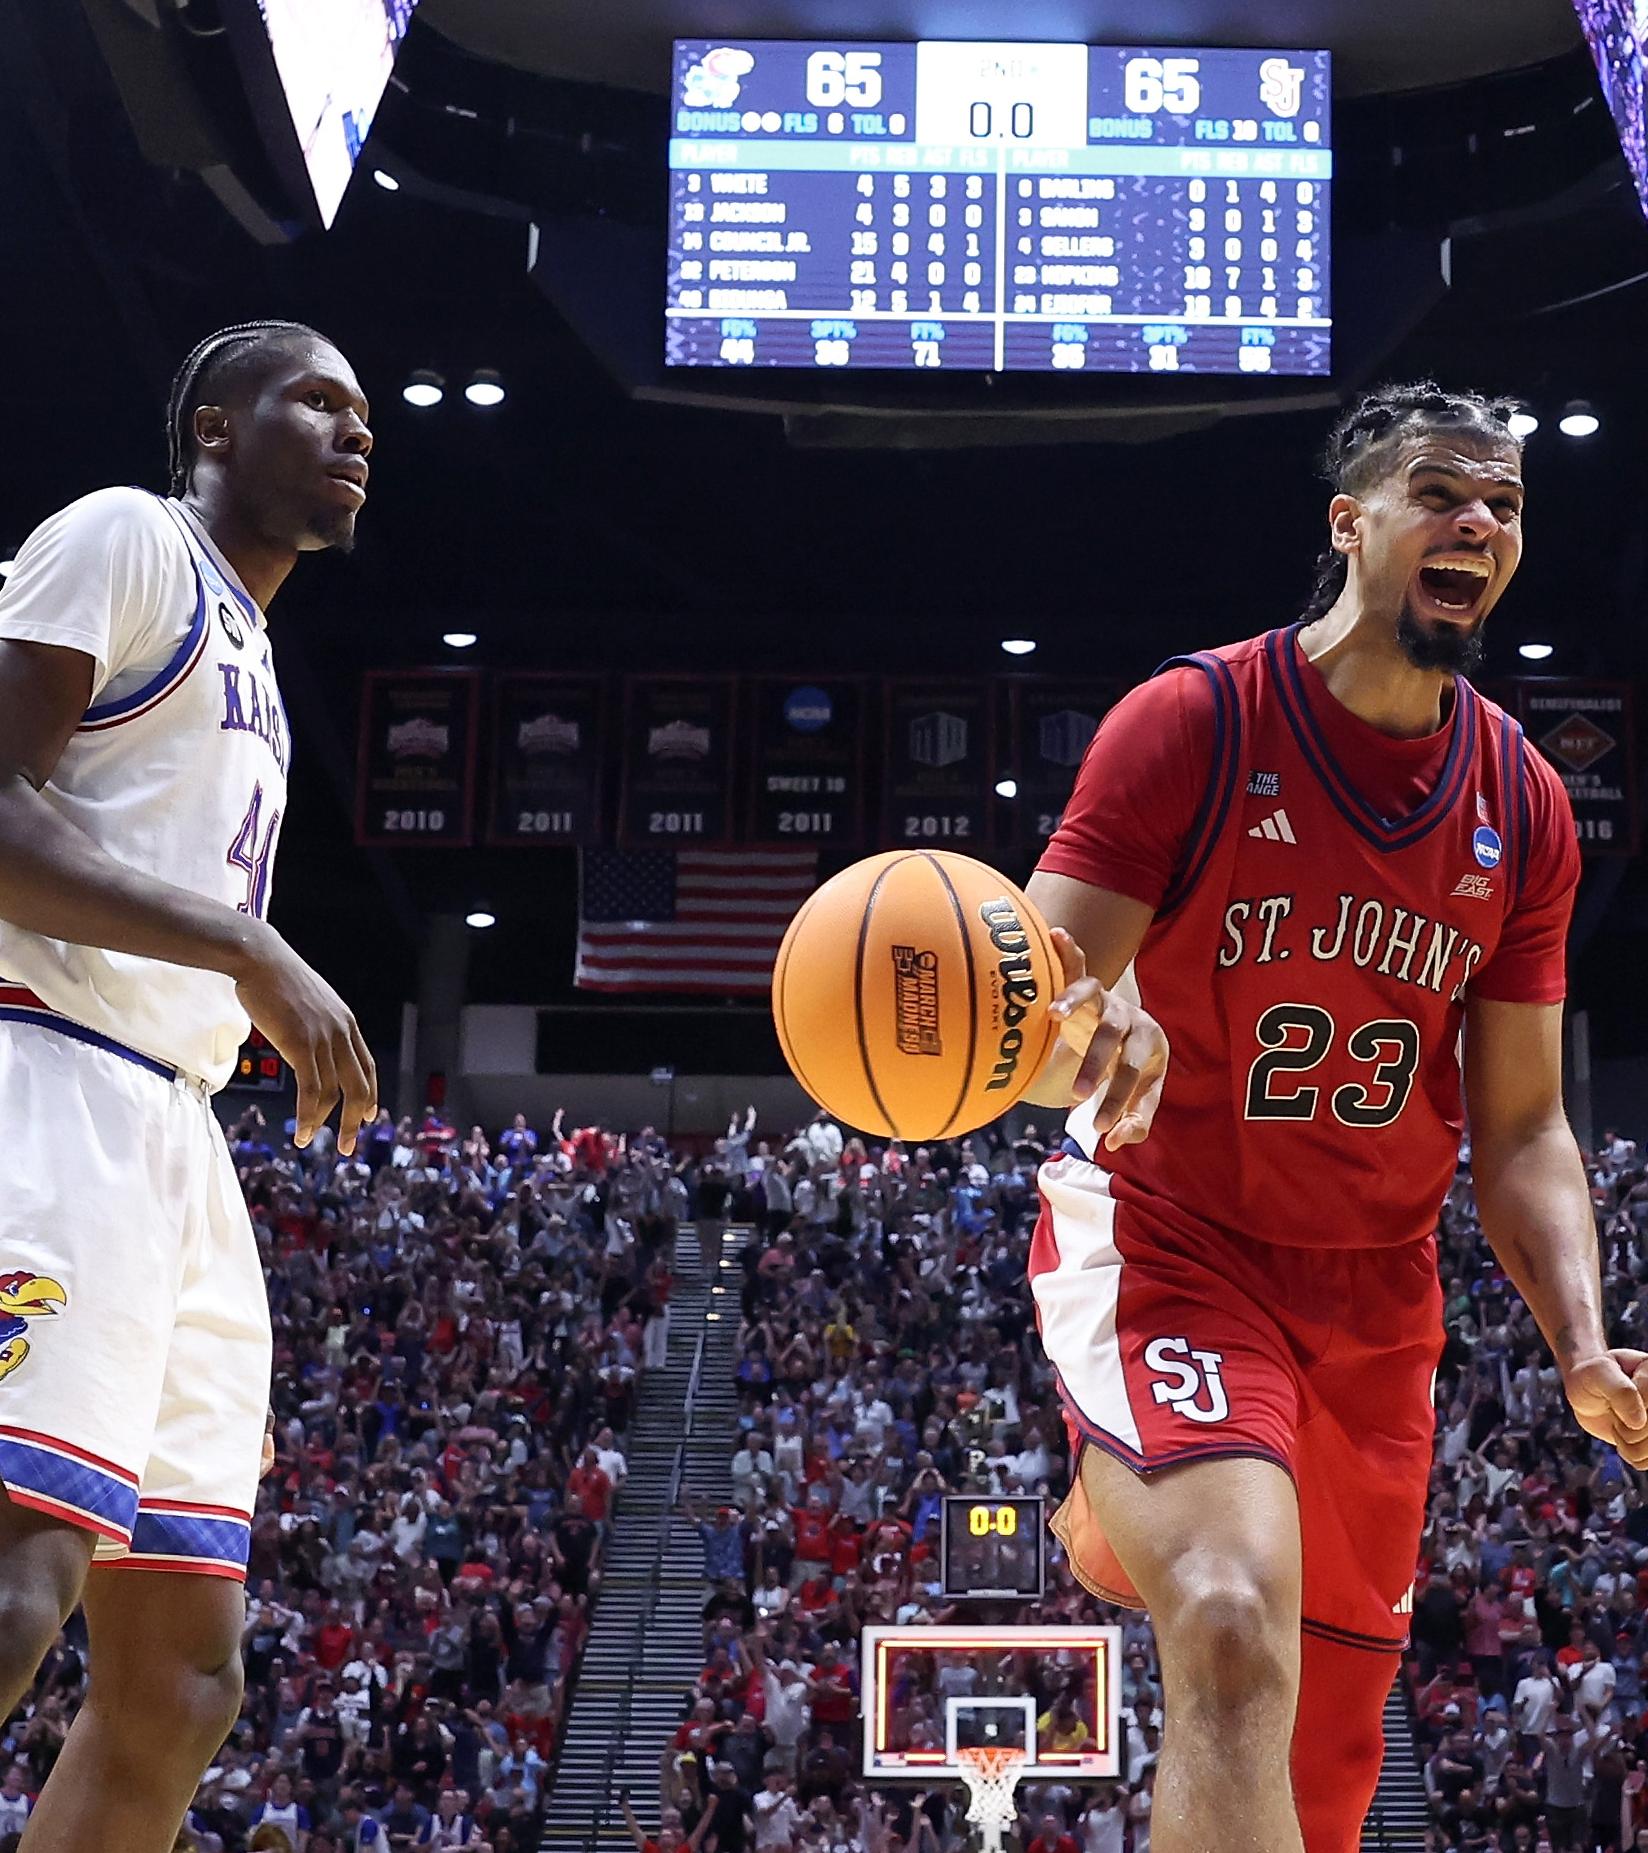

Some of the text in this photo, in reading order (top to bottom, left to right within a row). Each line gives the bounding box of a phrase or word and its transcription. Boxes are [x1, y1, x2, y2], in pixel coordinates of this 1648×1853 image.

[807, 52, 881, 107] 65
[1125, 58, 1200, 113] 65
[677, 111, 741, 132] BONUS
[784, 113, 818, 134] FLS
[851, 114, 887, 135] TOL
[970, 102, 1033, 138] 0.0
[1089, 119, 1153, 138] BONUS
[1195, 121, 1229, 141] FLS
[1262, 121, 1297, 142] TOL
[850, 147, 880, 165] PTS
[959, 149, 987, 168] FLS
[1180, 153, 1211, 171] PTS
[1289, 155, 1318, 174] FLS
[857, 175, 873, 197] 4
[894, 175, 909, 197] 5
[1189, 179, 1205, 202] 0
[1226, 180, 1239, 203] 1
[1260, 181, 1276, 203] 4
[1297, 182, 1313, 204] 0
[856, 203, 873, 225] 4
[929, 204, 945, 227] 0
[966, 205, 981, 227] 0
[1225, 209, 1241, 232] 0
[1263, 210, 1275, 232] 1
[851, 232, 877, 255] 15
[928, 233, 944, 256] 4
[966, 234, 979, 256] 1
[1041, 236, 1114, 257] SELLERS
[1225, 238, 1241, 261] 0
[1261, 239, 1277, 261] 0
[1296, 240, 1313, 262] 4
[851, 261, 876, 284] 21
[891, 262, 908, 284] 4
[928, 262, 944, 285] 0
[965, 263, 980, 285] 0
[1041, 265, 1118, 286] HOPKINS
[1226, 267, 1240, 289] 7
[1263, 268, 1275, 290] 1
[928, 290, 943, 313] 1
[963, 291, 980, 314] 4
[1260, 296, 1277, 318] 4
[913, 341, 940, 366] 71
[1246, 782, 1280, 797] ANGE
[1256, 772, 1279, 785] THE
[384, 810, 444, 831] 2010
[518, 812, 572, 832] 2011
[649, 813, 703, 833] 2011
[778, 812, 832, 833] 2011
[905, 816, 970, 837] 2012
[1455, 883, 1494, 898] EAST
[1460, 874, 1491, 888] BIG
[1218, 895, 1483, 1002] ST. JOHN'S
[919, 968, 937, 1029] MARCH
[978, 896, 1039, 1092] Wilson
[1243, 1002, 1420, 1128] 23
[1143, 1335, 1230, 1424] SJ
